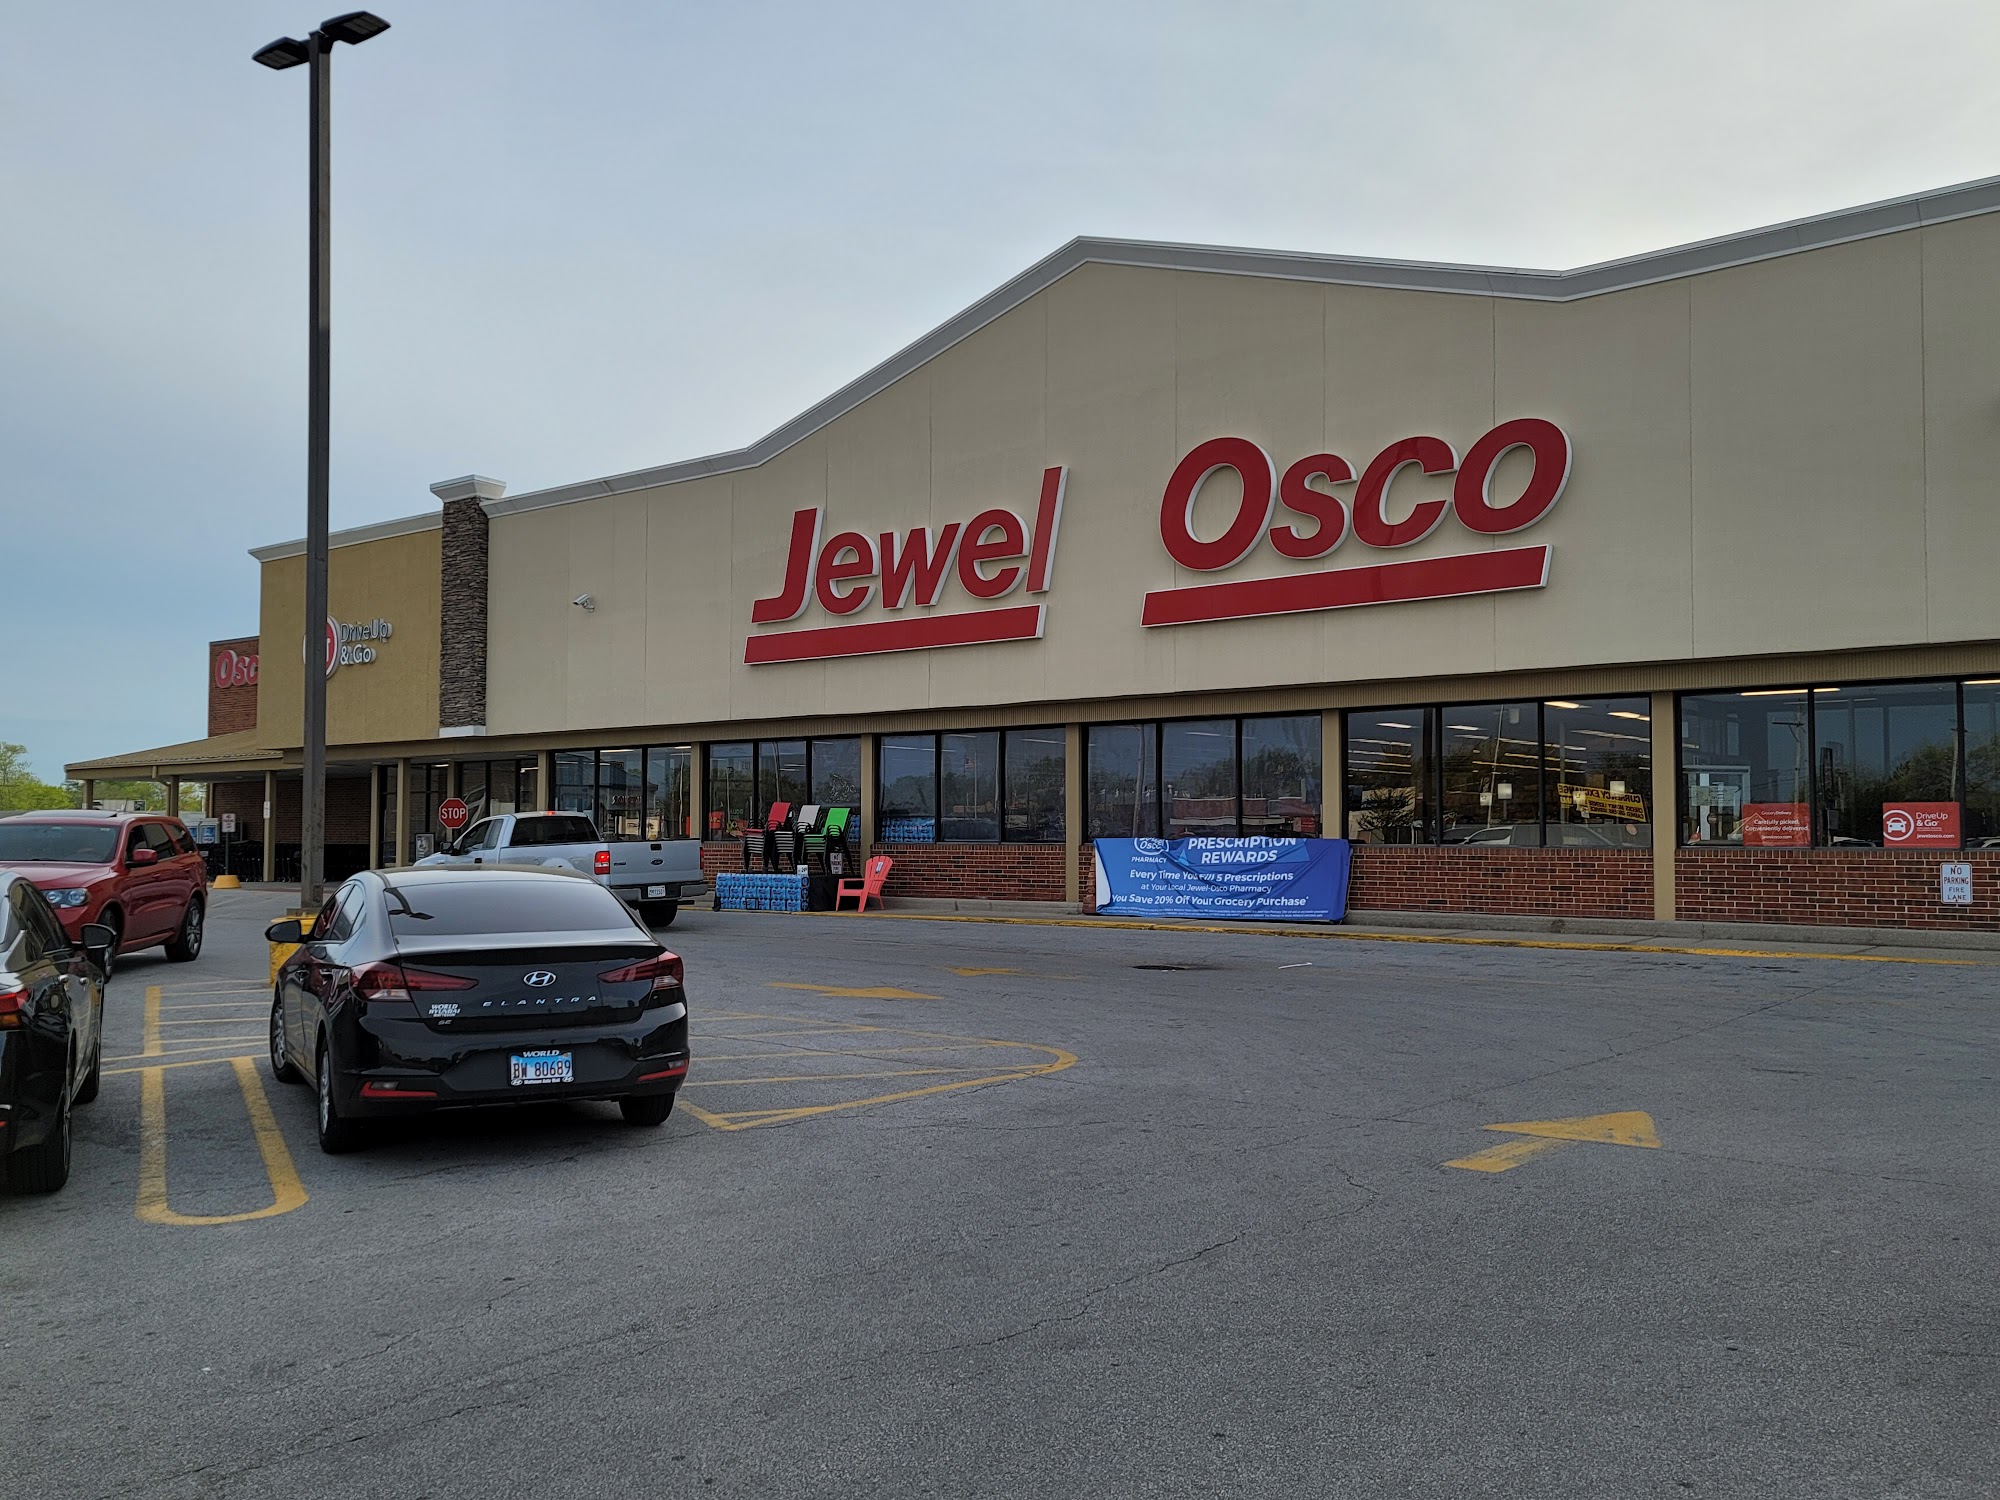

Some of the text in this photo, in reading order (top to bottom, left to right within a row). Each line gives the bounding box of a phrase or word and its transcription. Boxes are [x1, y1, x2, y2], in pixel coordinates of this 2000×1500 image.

[750, 417, 1573, 625] Jewel Osco
[340, 619, 391, 643] DriveUp
[340, 645, 374, 666] & Go
[214, 650, 260, 688] Osc
[441, 807, 466, 819] STOP
[1915, 812, 1948, 823] DriveUp
[1753, 819, 1800, 827] Carefully picked.
[1188, 836, 1297, 850] PRESCRIPTION
[1131, 856, 1167, 864] PHARMACY
[1201, 850, 1278, 864] REWARDS
[1129, 869, 1157, 881] Every
[1158, 870, 1181, 880] Time
[1216, 873, 1223, 882] 5
[1223, 871, 1294, 884] Prescriptions
[1950, 867, 1963, 875] NO
[1943, 877, 1969, 885] PARKING
[1151, 883, 1169, 891] Your
[1186, 885, 1228, 893] Jewel-Osco
[1229, 885, 1272, 895] Pharmacy
[1111, 894, 1127, 903] You
[1128, 894, 1154, 905] Save
[1154, 895, 1174, 905] 20%
[1175, 895, 1191, 905] Off
[1191, 896, 1213, 906] Your
[1213, 897, 1256, 908] Grocery
[482, 995, 597, 1007] ELANTRA
[522, 1050, 560, 1058] WORLD
[534, 1060, 571, 1077] 80689
